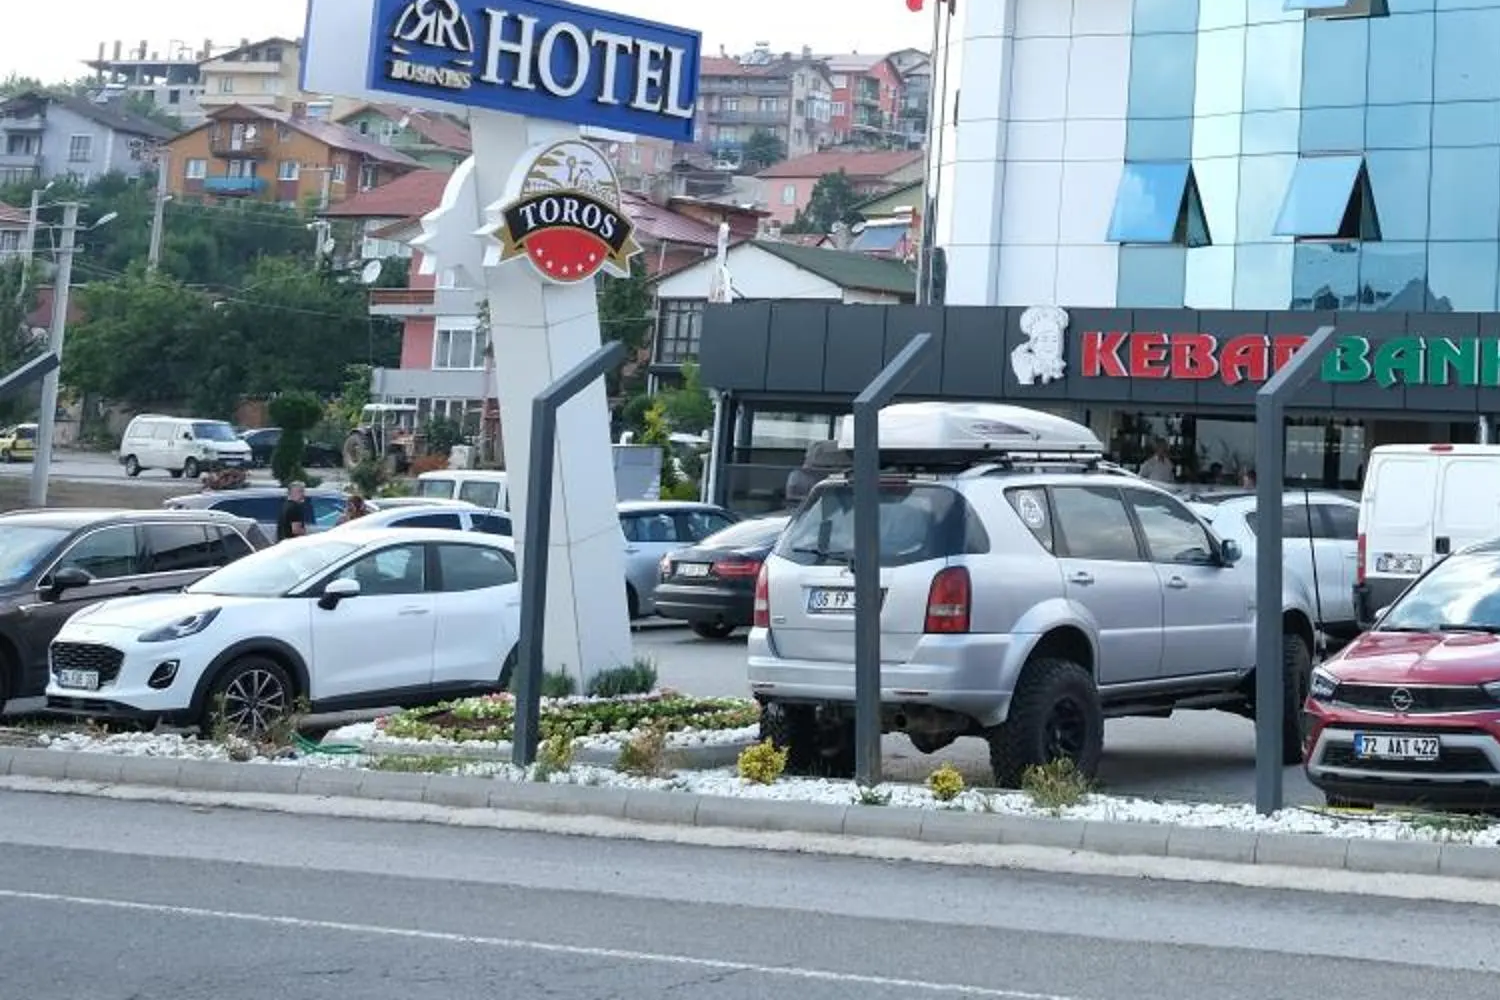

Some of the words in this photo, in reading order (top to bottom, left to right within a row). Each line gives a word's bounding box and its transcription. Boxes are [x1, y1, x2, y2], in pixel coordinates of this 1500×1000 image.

[480, 6, 696, 119] HOTEL
[519, 198, 618, 240] TOROS
[1364, 737, 1377, 752] 72
[1413, 739, 1437, 755] 422
